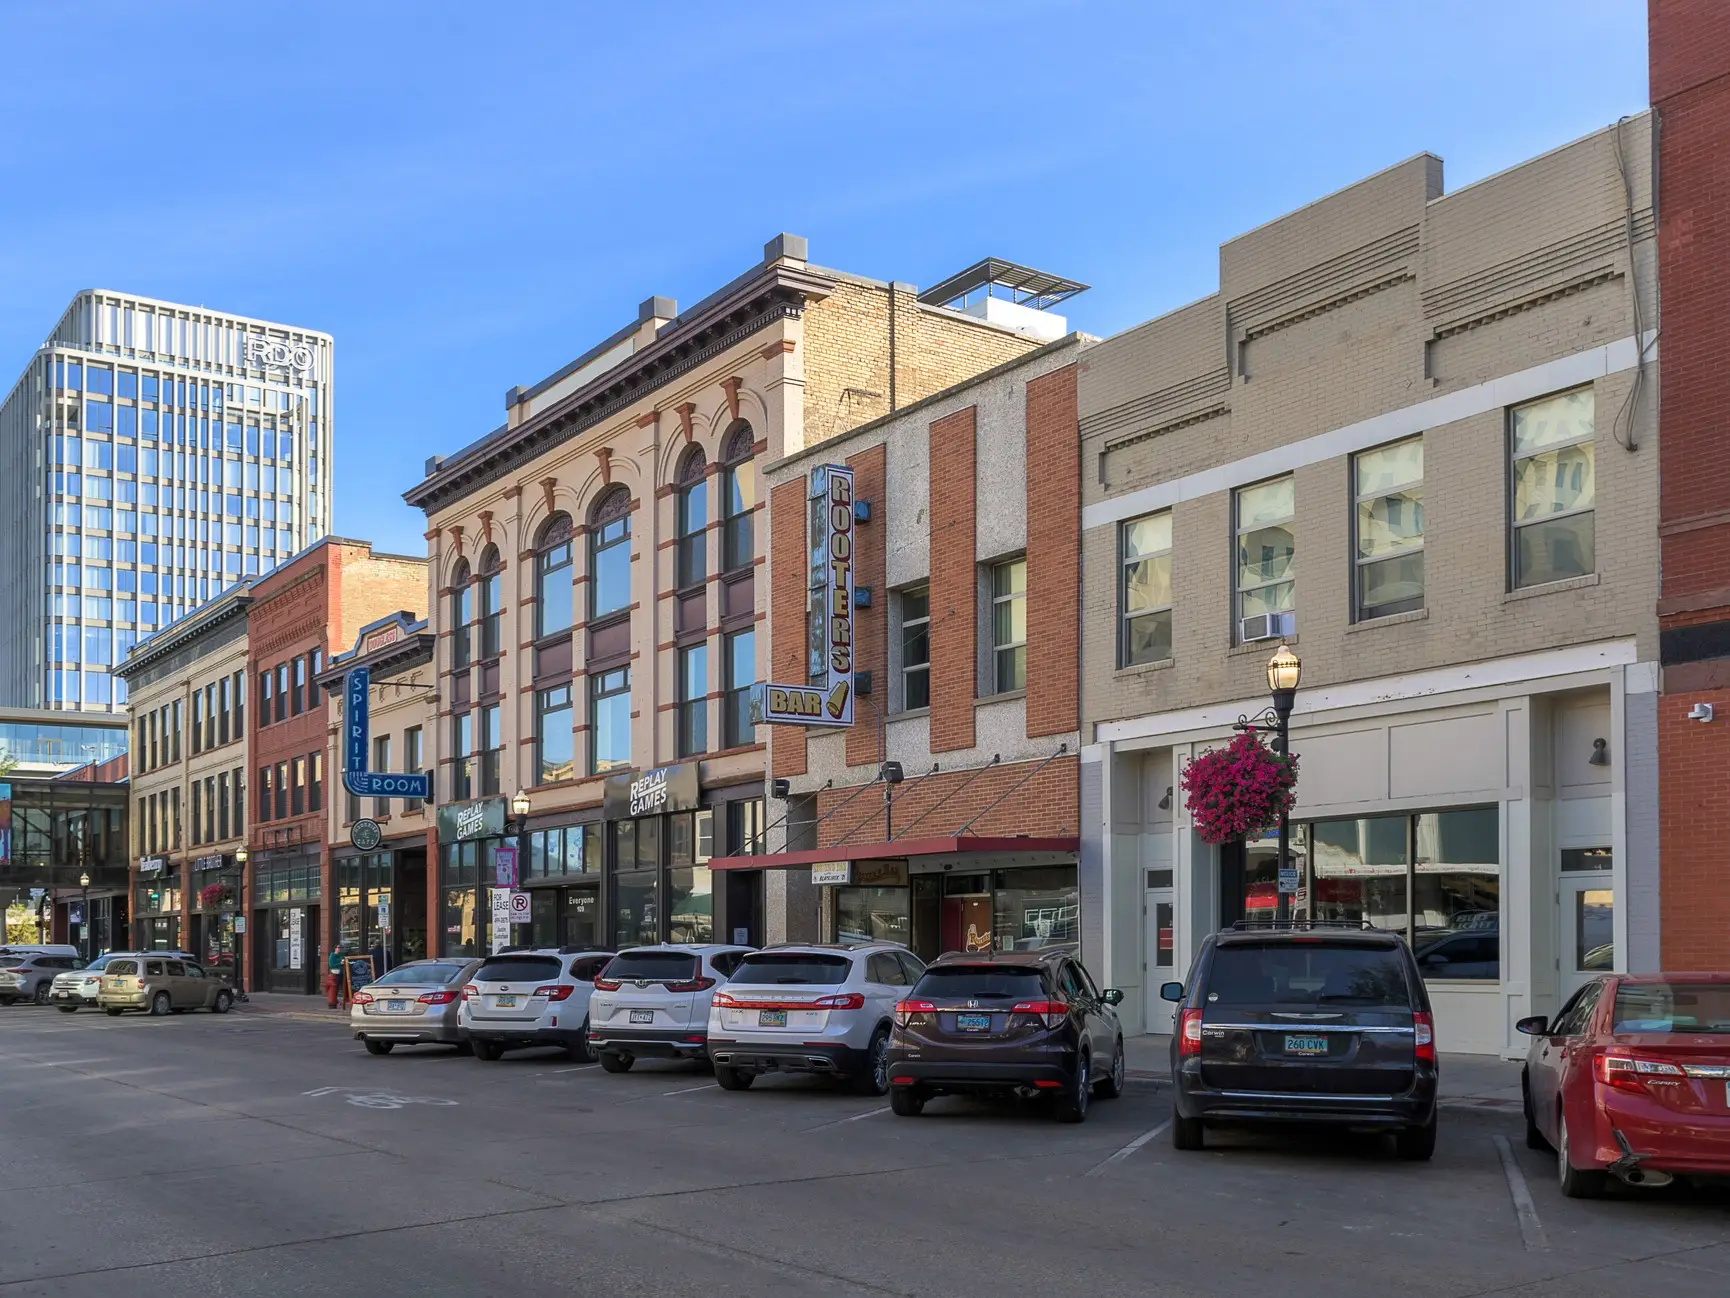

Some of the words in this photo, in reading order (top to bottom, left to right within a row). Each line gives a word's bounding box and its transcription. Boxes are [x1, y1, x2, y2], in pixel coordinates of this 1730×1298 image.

[247, 337, 314, 371] RDO
[830, 475, 852, 673] ROOTERS
[769, 689, 822, 717] BAR
[352, 677, 363, 770] SPIRIT
[372, 778, 422, 793] ROOM
[630, 768, 667, 802] REPLAY
[630, 787, 667, 816] GAMES
[457, 801, 483, 828] REPLAY
[456, 817, 483, 840] GAMES
[494, 893, 502, 901] FOR
[494, 901, 509, 911] LEASE
[568, 896, 595, 906] Everyone
[1287, 1039, 1304, 1050] 260
[1307, 1039, 1325, 1050] CVK
[1647, 1079, 1681, 1088] Camry
